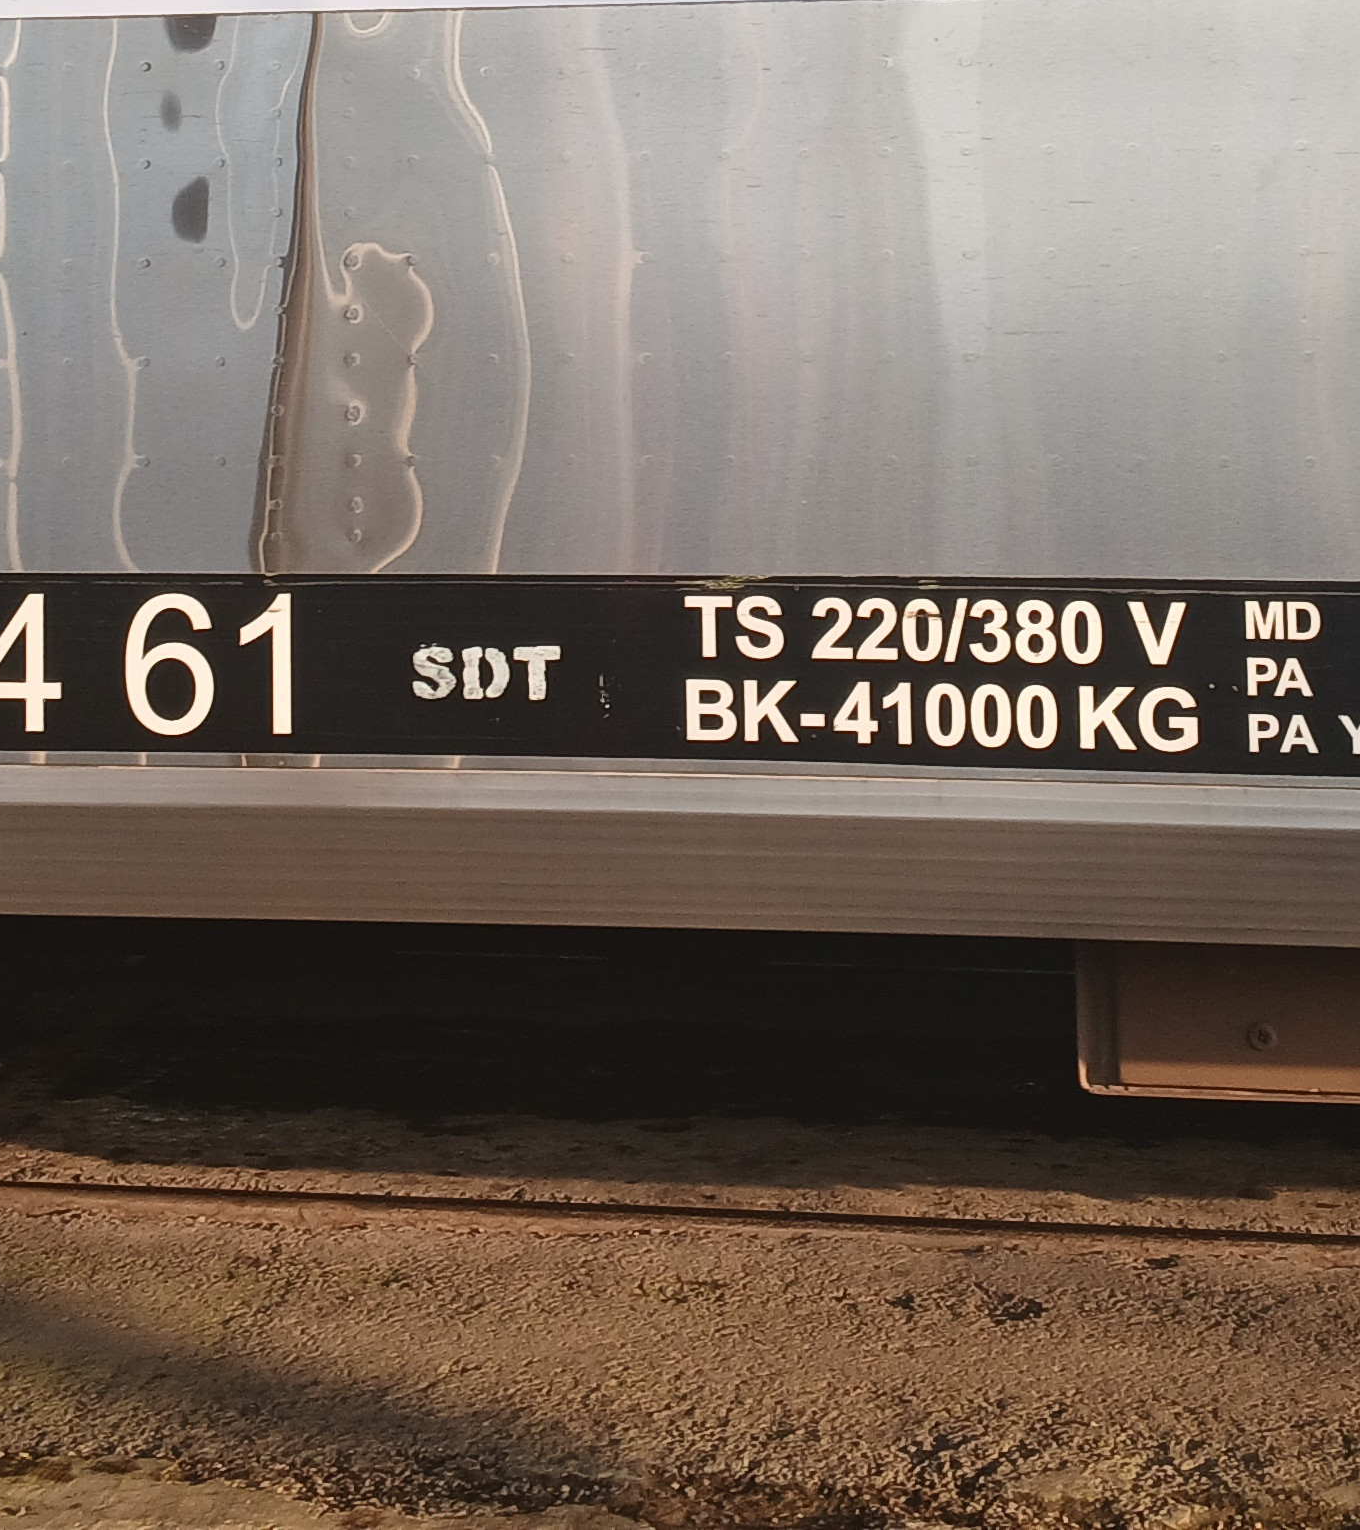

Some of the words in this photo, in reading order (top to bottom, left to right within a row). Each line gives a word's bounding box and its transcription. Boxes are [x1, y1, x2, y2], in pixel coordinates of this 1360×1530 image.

[684, 596, 784, 659] TS
[812, 597, 1102, 664] 220/380
[1127, 602, 1186, 665] V
[1245, 601, 1321, 640] MD
[126, 593, 292, 735] 61
[413, 645, 560, 700] SDT
[1247, 657, 1313, 697] PA
[685, 679, 1057, 748] BK-41000
[1079, 686, 1198, 752] KG
[1248, 714, 1318, 754] PA
